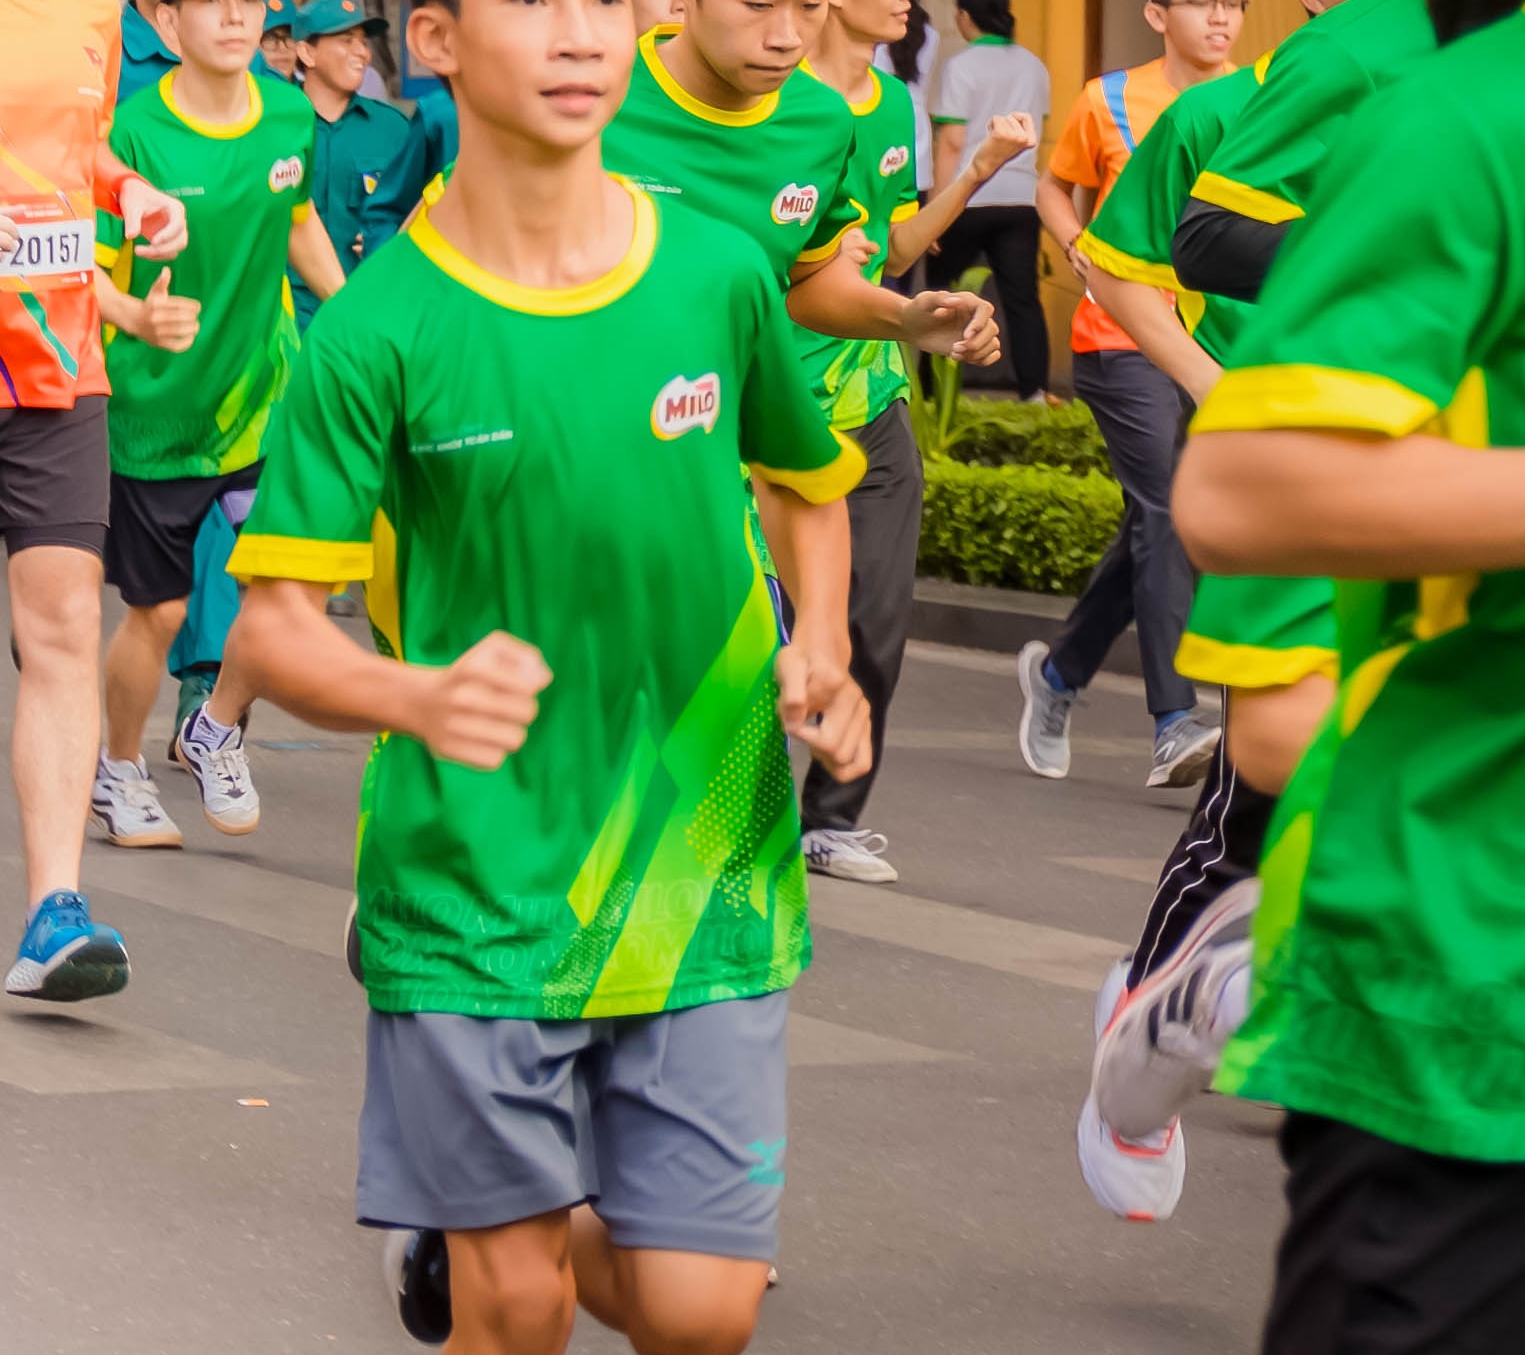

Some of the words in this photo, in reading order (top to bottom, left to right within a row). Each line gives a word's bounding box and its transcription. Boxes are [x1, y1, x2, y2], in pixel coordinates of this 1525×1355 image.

[780, 195, 814, 213] MILO
[10, 232, 80, 266] 20157
[665, 390, 715, 423] MILO
